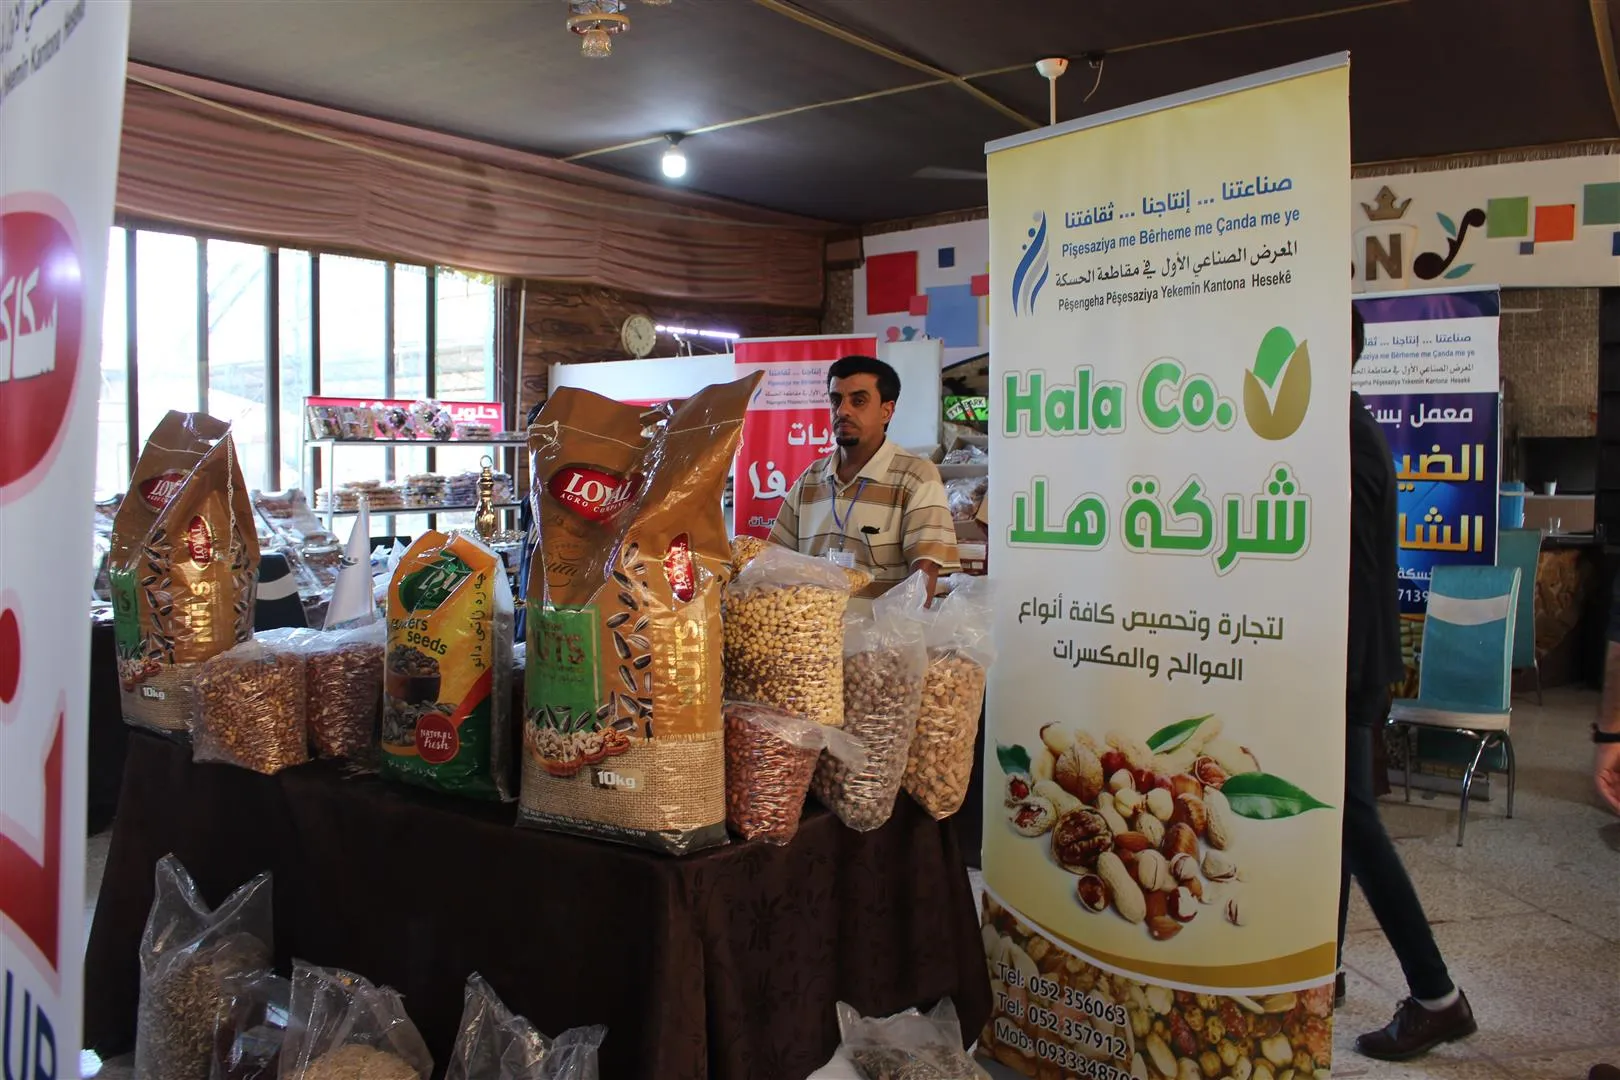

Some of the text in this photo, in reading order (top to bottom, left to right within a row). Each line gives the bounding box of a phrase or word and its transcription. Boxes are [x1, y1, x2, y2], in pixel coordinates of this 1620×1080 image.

[1142, 189, 1190, 218] إنتاجنا
[1221, 175, 1293, 201] صناعتنا
[1064, 202, 1115, 229] ثقافتنا
[1119, 235, 1136, 247] me
[1140, 228, 1192, 245] Bêrheme
[1195, 223, 1213, 236] me
[1216, 213, 1257, 236] Çanda
[1261, 212, 1281, 226] me
[1284, 208, 1300, 226] ye
[1055, 240, 1298, 287] المعرض الصناعي الأول في مقاطعة الحسكة
[1203, 278, 1246, 293] Kantona
[1251, 269, 1292, 288] Hesekê
[1004, 360, 1235, 436] Hala Co.
[1410, 402, 1473, 428] معمل
[559, 493, 588, 508] AGRO
[563, 472, 633, 508] LOYAL
[1008, 466, 1308, 572] شركة هلا
[1018, 593, 1283, 645] لتجارة وتحميص كافة أنواع
[407, 630, 448, 655] seeds
[1053, 639, 1242, 683] الموالح والمكسرات
[597, 770, 636, 789] 10kg
[997, 962, 1127, 1026] Tel: 052 356063
[995, 1022, 1033, 1050] Mob:
[997, 992, 1127, 1059] Tel: 052 357912
